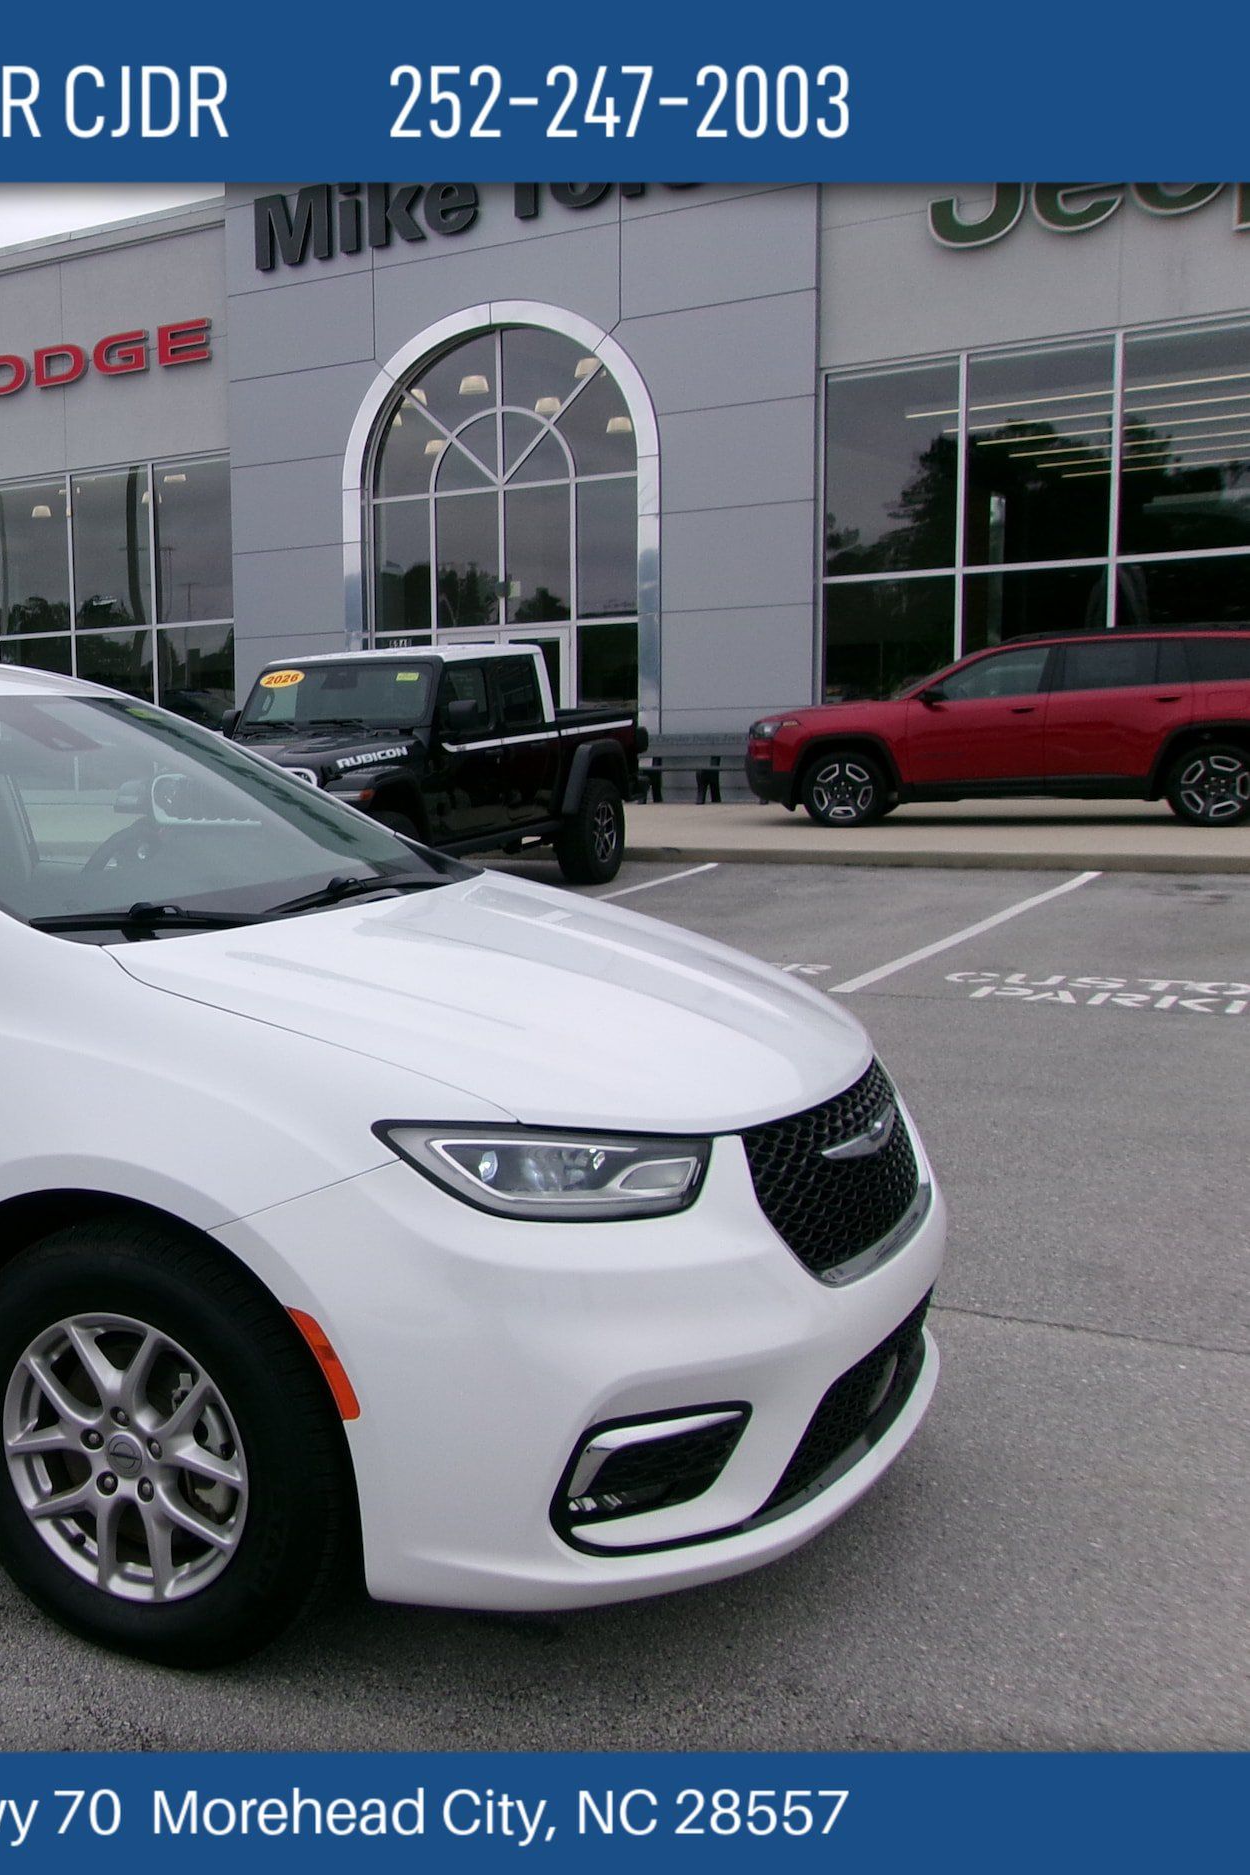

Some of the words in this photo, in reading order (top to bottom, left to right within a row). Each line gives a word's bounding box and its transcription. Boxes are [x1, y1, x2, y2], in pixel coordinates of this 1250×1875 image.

[253, 182, 479, 272] Mike
[264, 673, 299, 686] 2026
[336, 746, 408, 769] RUBICON
[968, 985, 1249, 1014] PARKI
